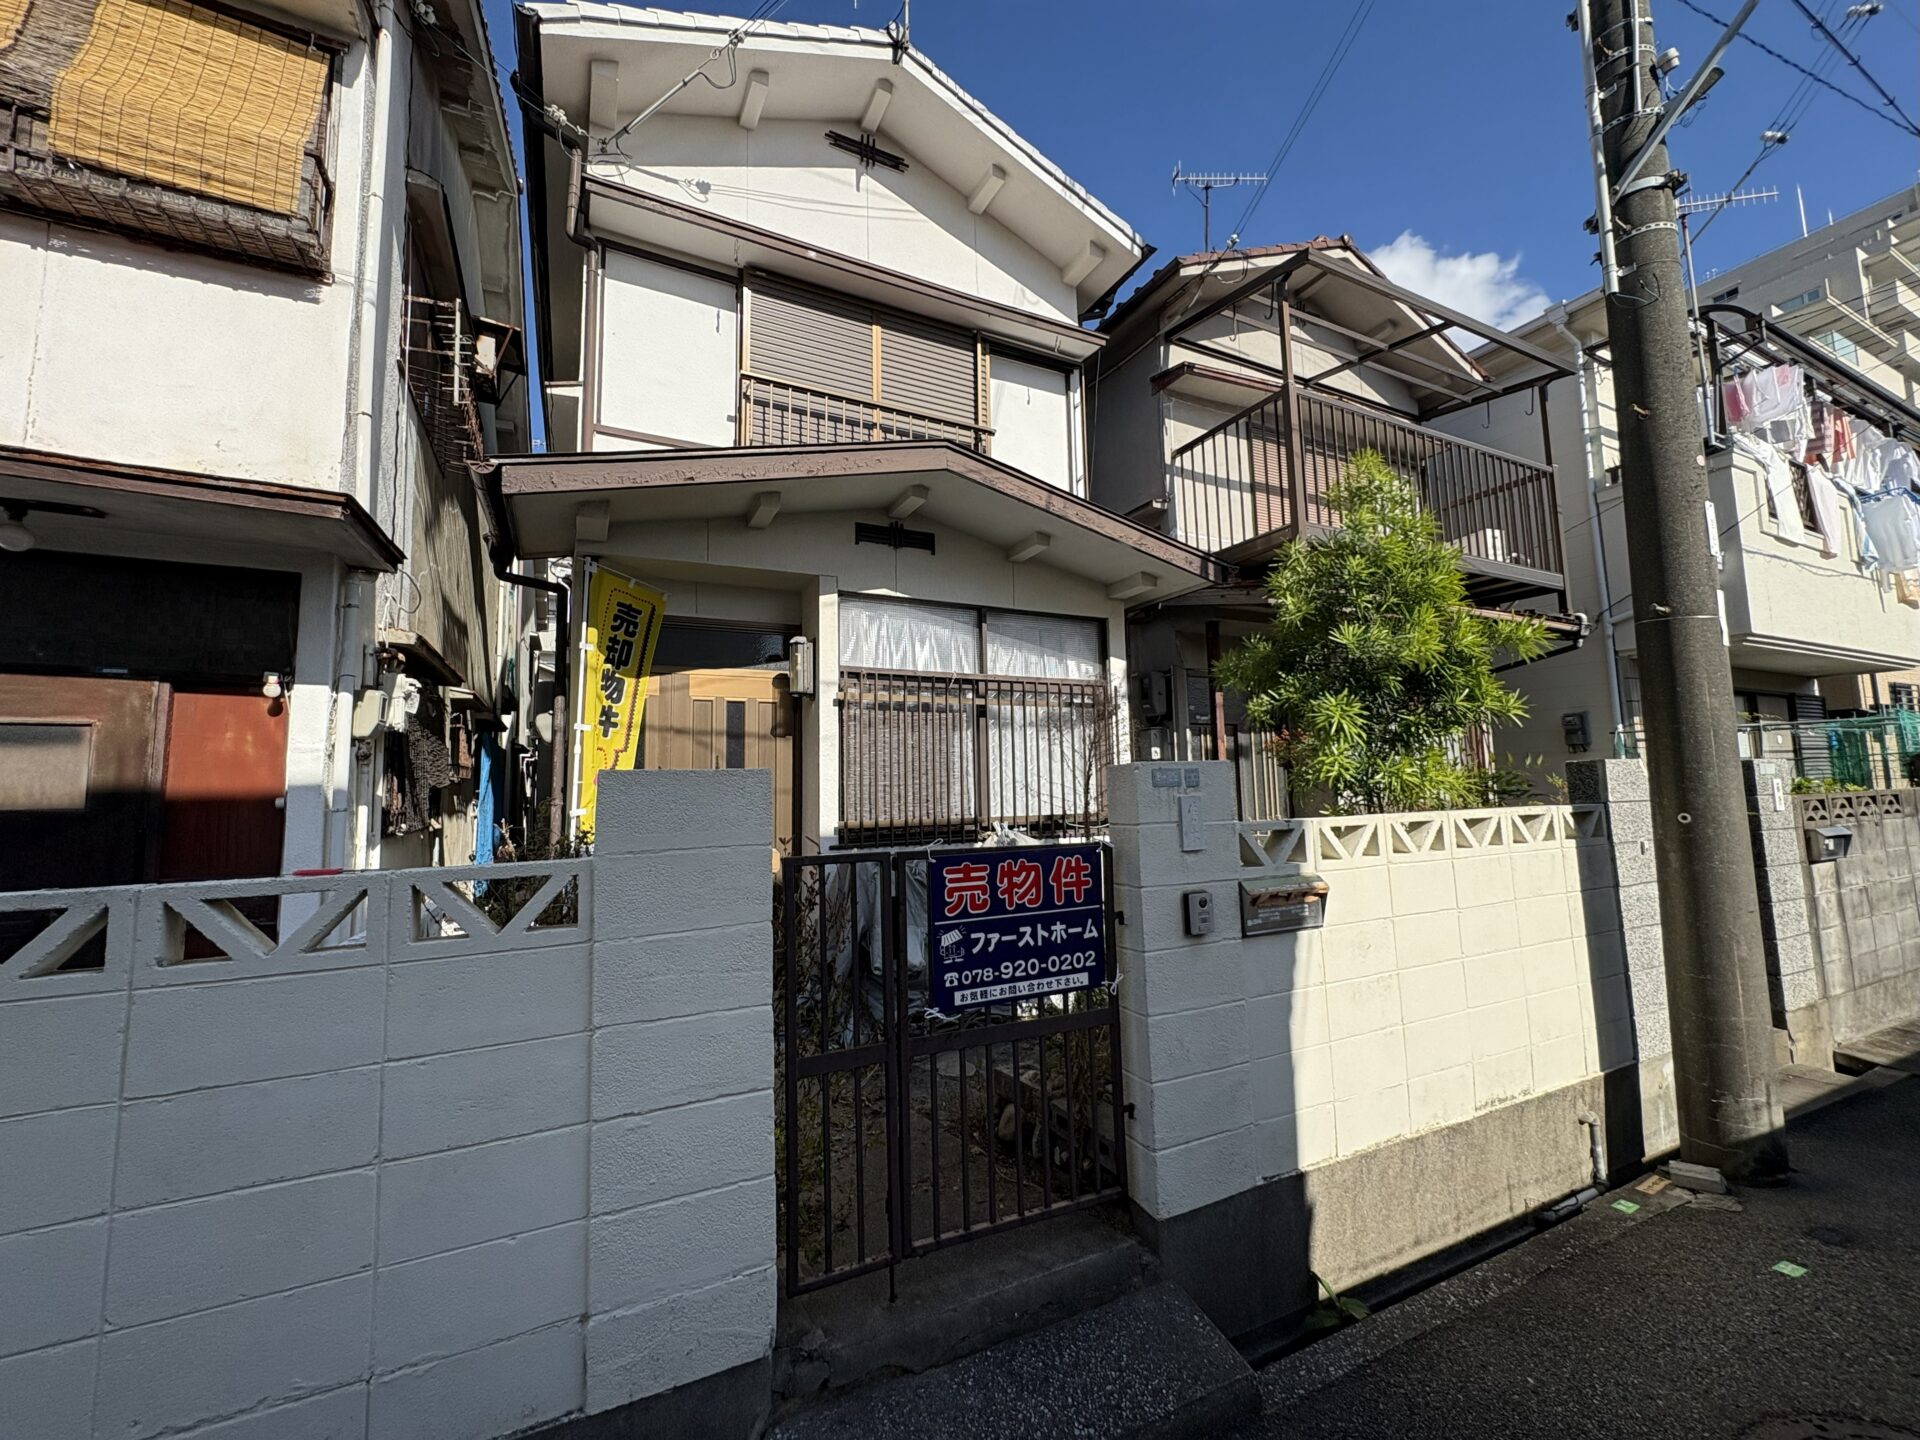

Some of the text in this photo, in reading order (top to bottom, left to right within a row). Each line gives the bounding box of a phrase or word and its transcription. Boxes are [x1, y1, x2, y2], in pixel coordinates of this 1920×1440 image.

[943, 855, 1092, 917] 売物件
[970, 918, 1099, 954] ファーストホーム
[961, 951, 1096, 984] 078-920-0202
[959, 976, 1085, 1003] お気軽にお問い合わせ下さい。
